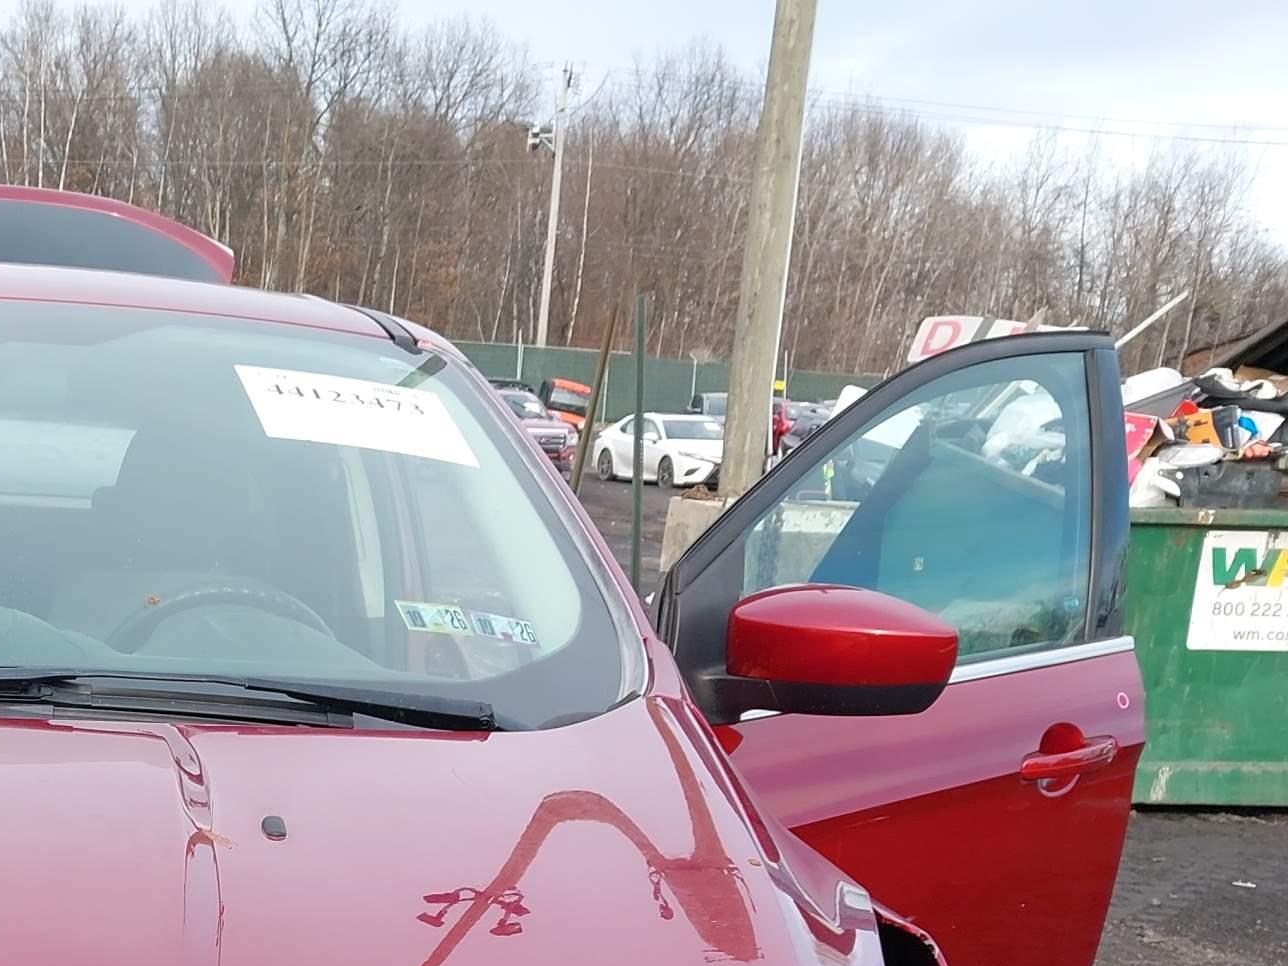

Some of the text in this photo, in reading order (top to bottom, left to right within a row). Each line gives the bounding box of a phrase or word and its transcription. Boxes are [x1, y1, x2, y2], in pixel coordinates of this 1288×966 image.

[266, 383, 425, 416] 44123473
[444, 608, 468, 631] 26
[1211, 601, 1283, 617] 800 222
[515, 621, 537, 643] 26
